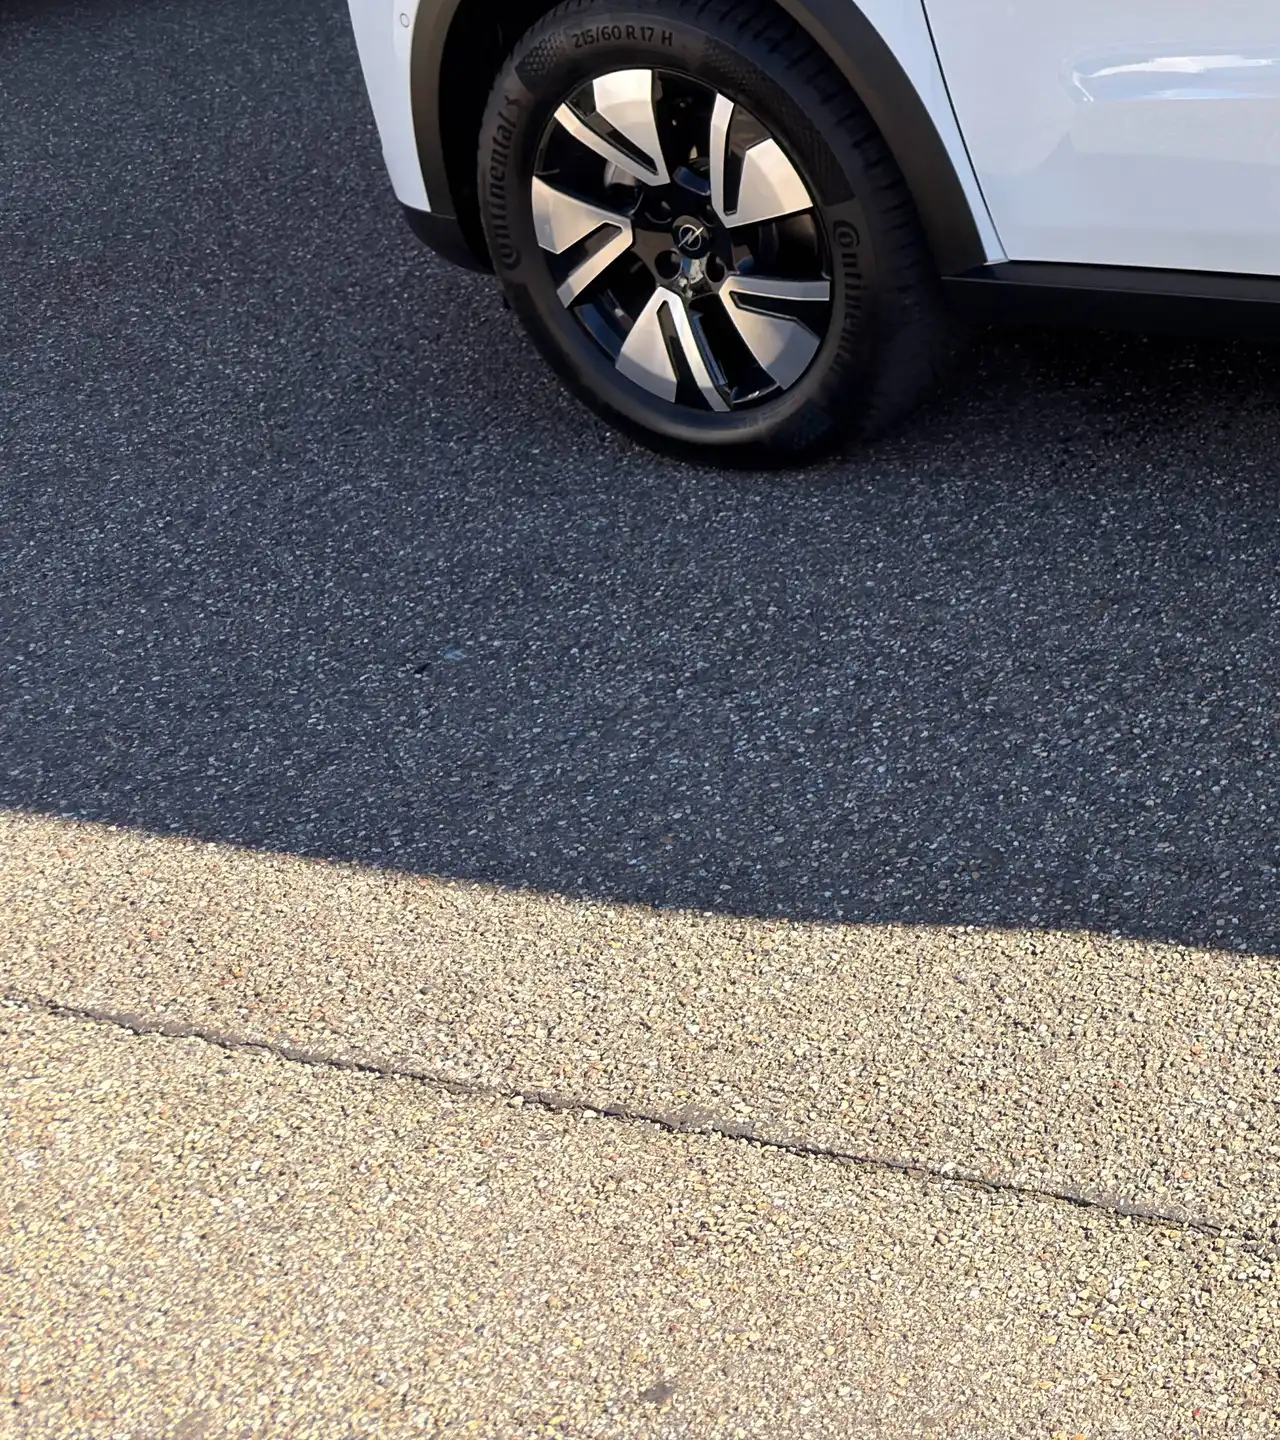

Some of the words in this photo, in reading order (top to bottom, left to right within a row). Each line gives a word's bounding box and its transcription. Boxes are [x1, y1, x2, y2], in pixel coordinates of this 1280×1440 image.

[571, 25, 622, 49] 215/60
[625, 25, 637, 41] R
[640, 26, 655, 42] 17
[660, 30, 674, 47] H
[488, 109, 521, 271] Continental
